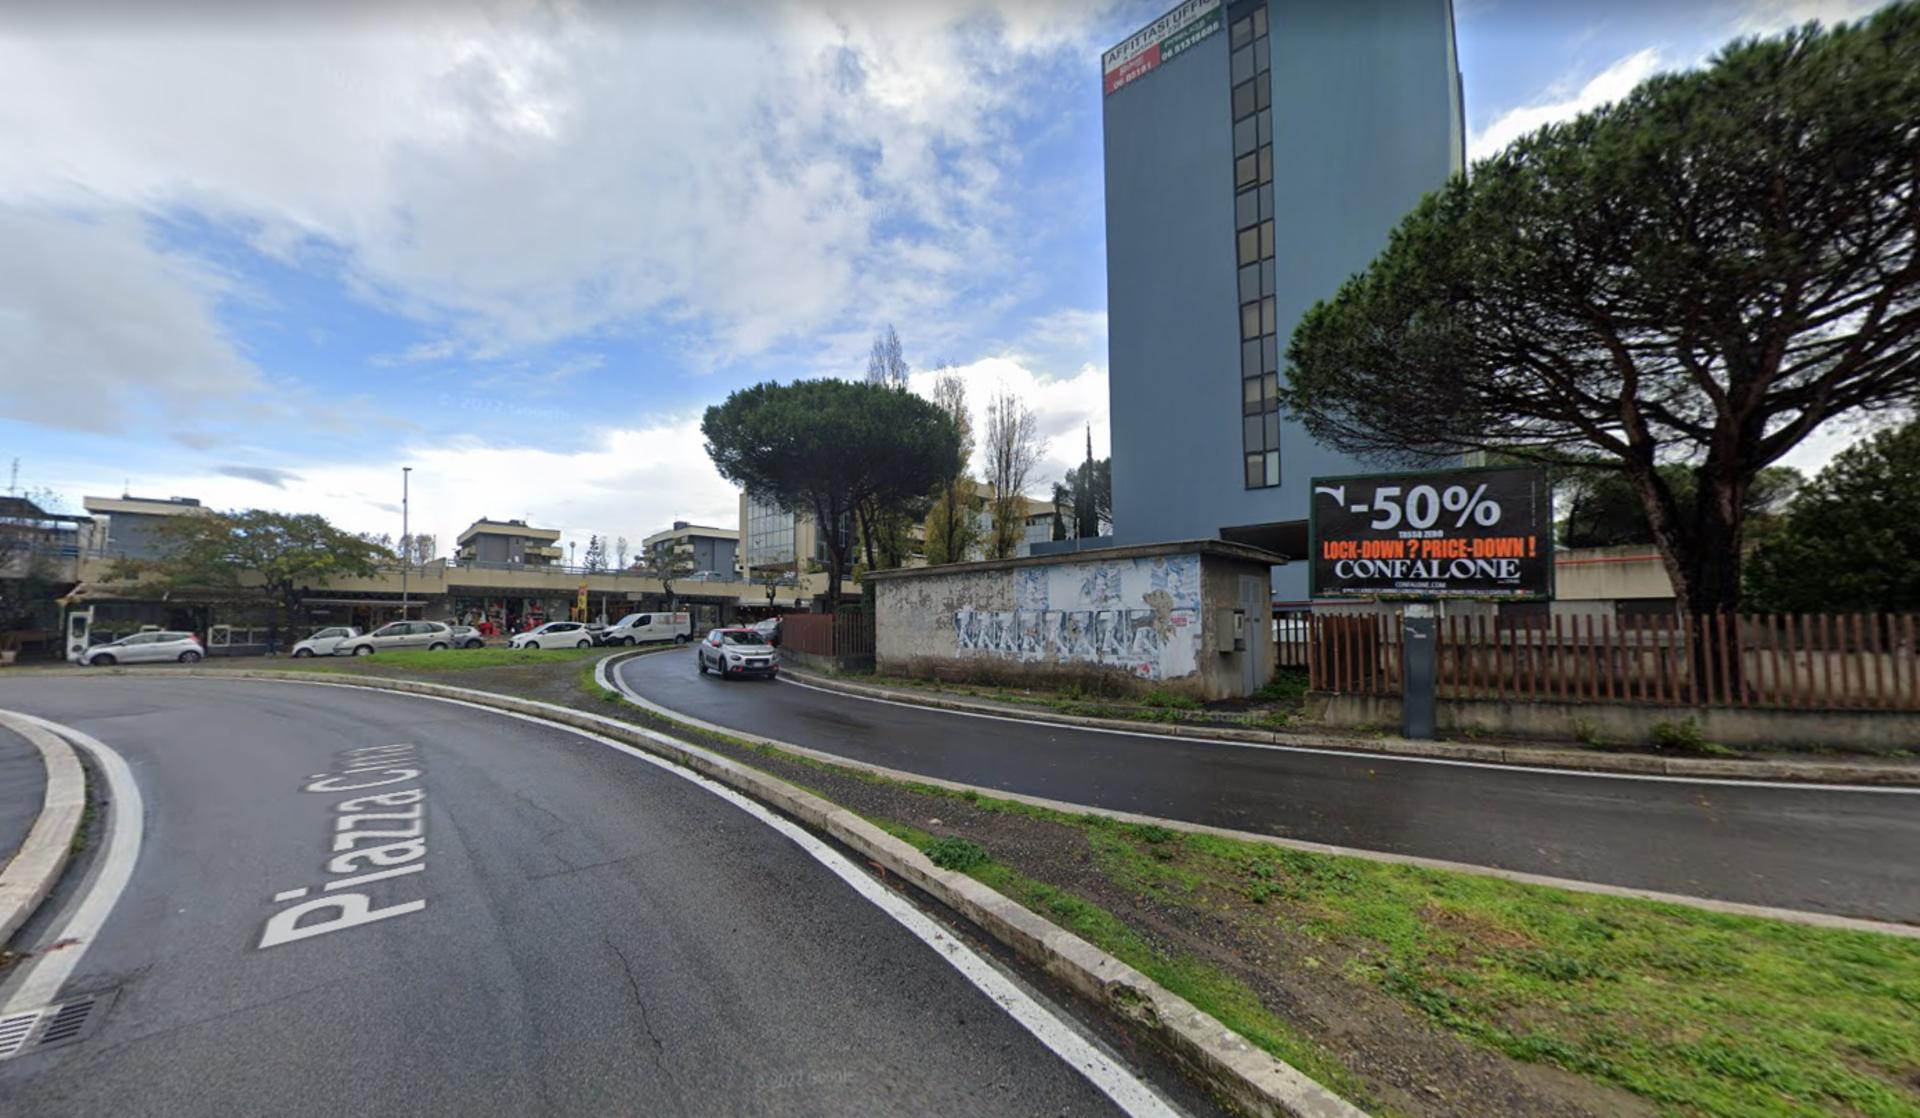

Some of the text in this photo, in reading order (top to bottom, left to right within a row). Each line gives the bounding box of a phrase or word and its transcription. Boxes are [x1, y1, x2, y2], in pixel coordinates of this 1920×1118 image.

[1107, 20, 1169, 64] AFFITTASI
[1350, 483, 1501, 530] -50%
[1323, 536, 1536, 560] LOCK-DOWN ? PRICE-DOWN !
[1335, 559, 1521, 579] CONFALONE
